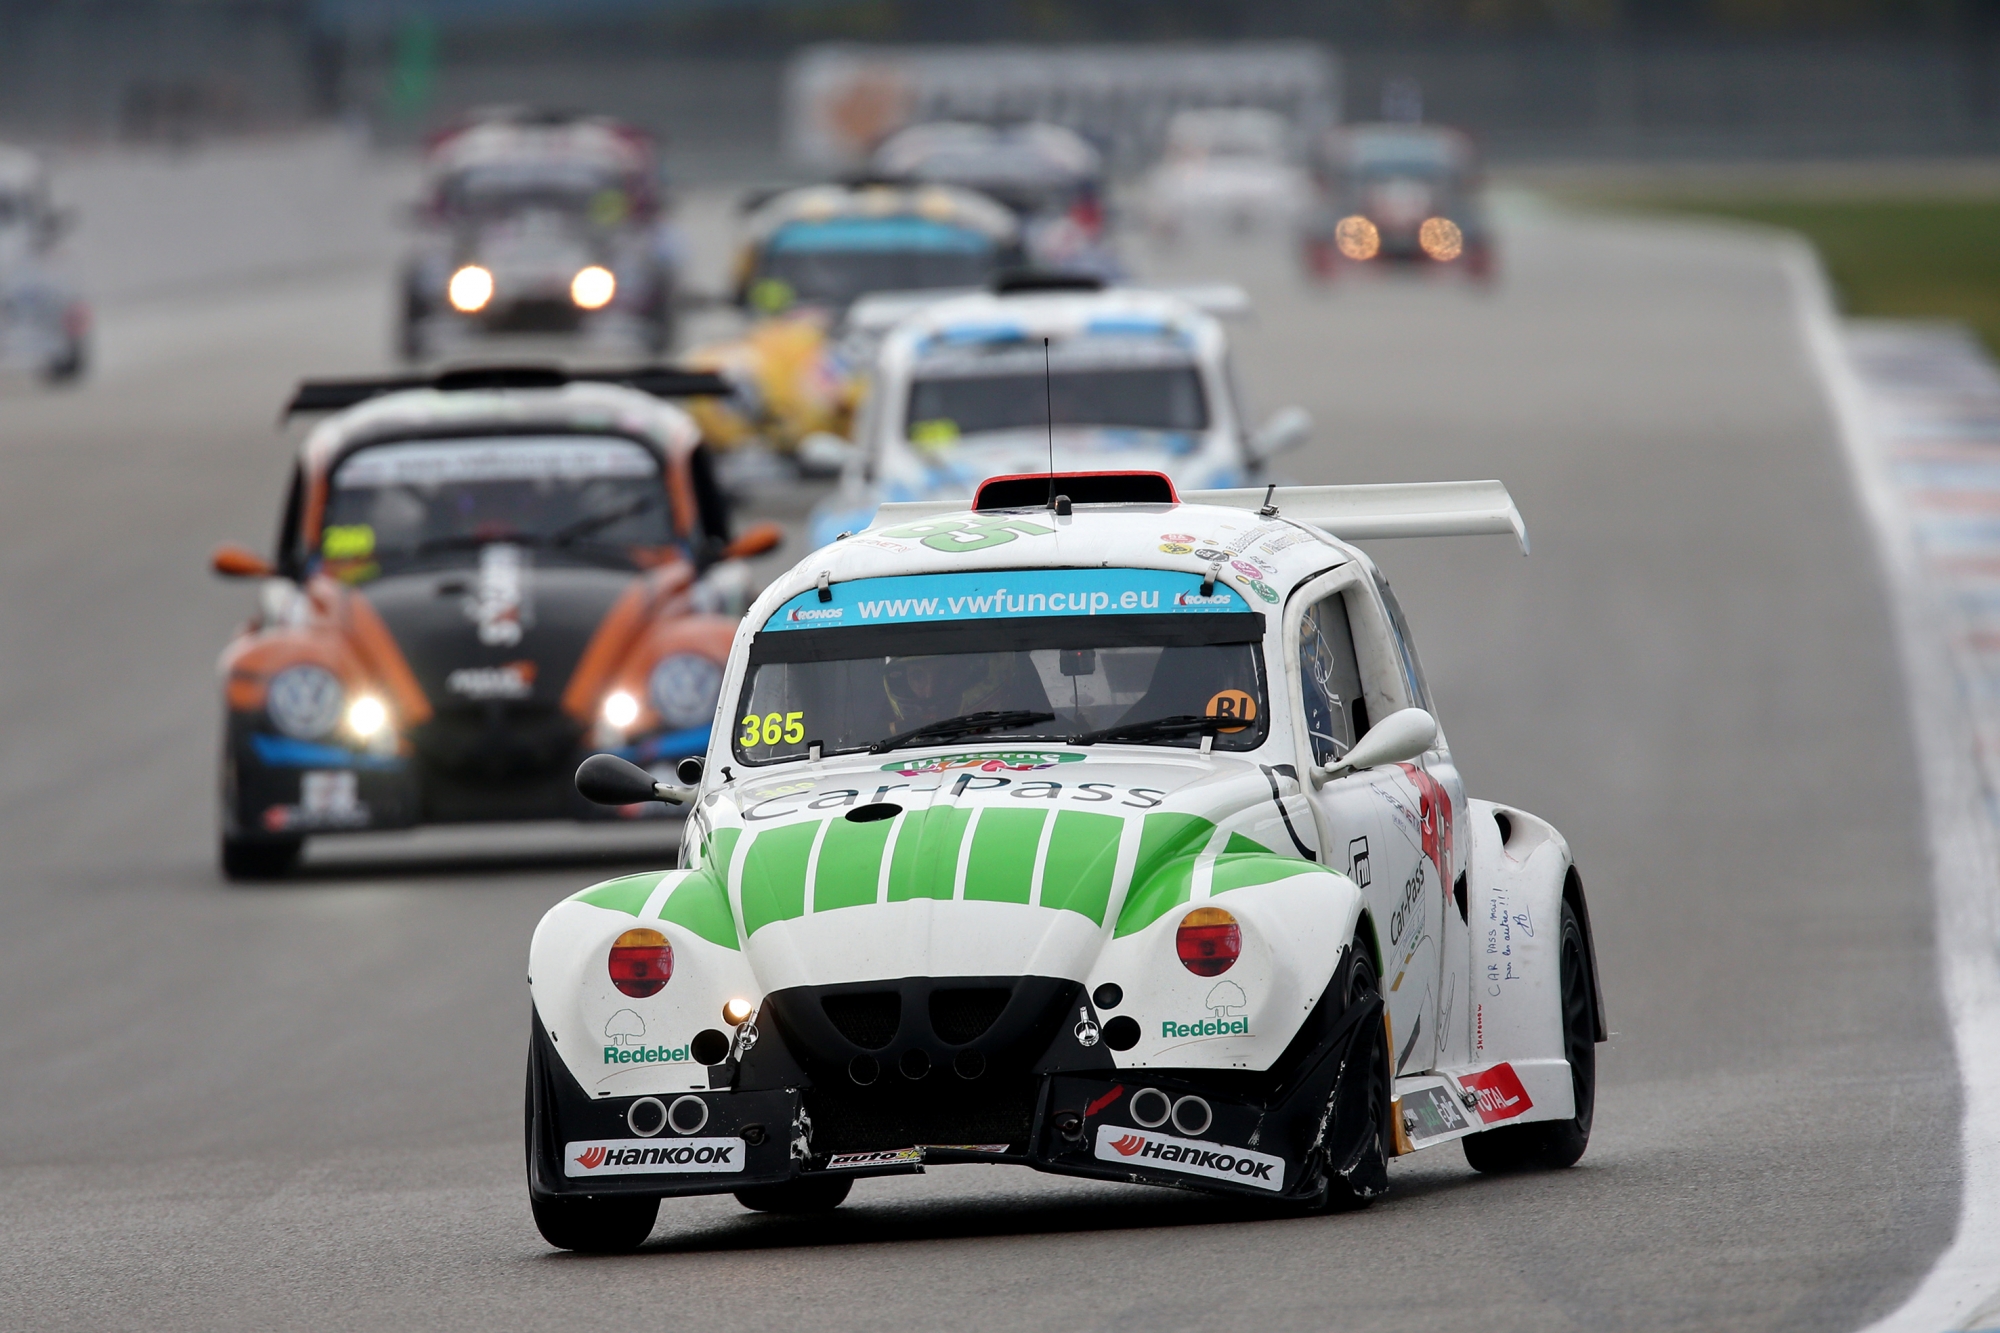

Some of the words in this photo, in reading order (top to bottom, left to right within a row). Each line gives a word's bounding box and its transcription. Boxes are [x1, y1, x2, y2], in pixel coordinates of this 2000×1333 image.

[858, 589, 1159, 619] www.vwfuncup.eu
[1173, 590, 1231, 606] KRONOS
[787, 605, 843, 622] KRONOS
[739, 711, 805, 747] 365
[1162, 1017, 1248, 1038] Redebel
[604, 1044, 689, 1064] Redebel
